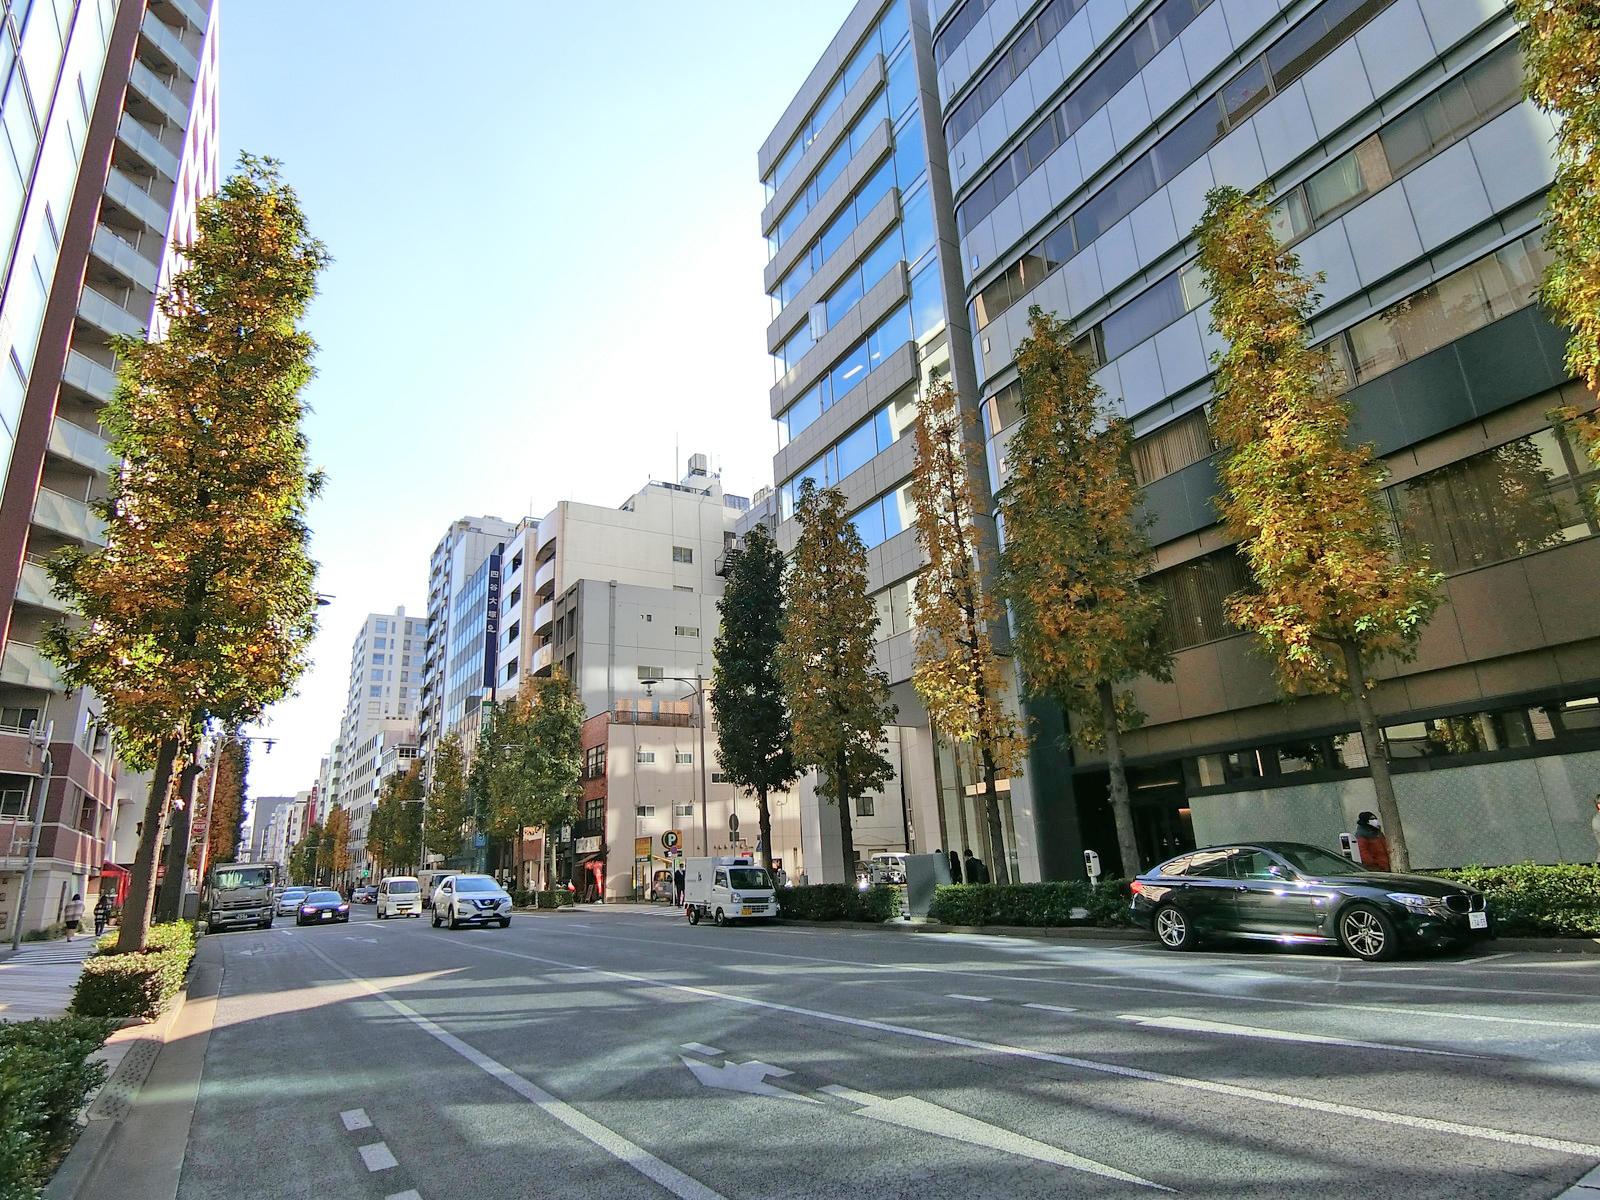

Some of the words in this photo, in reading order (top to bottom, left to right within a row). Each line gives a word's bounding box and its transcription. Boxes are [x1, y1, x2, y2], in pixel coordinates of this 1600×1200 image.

[488, 570, 499, 619] 四谷大塚
[668, 833, 677, 845] P
